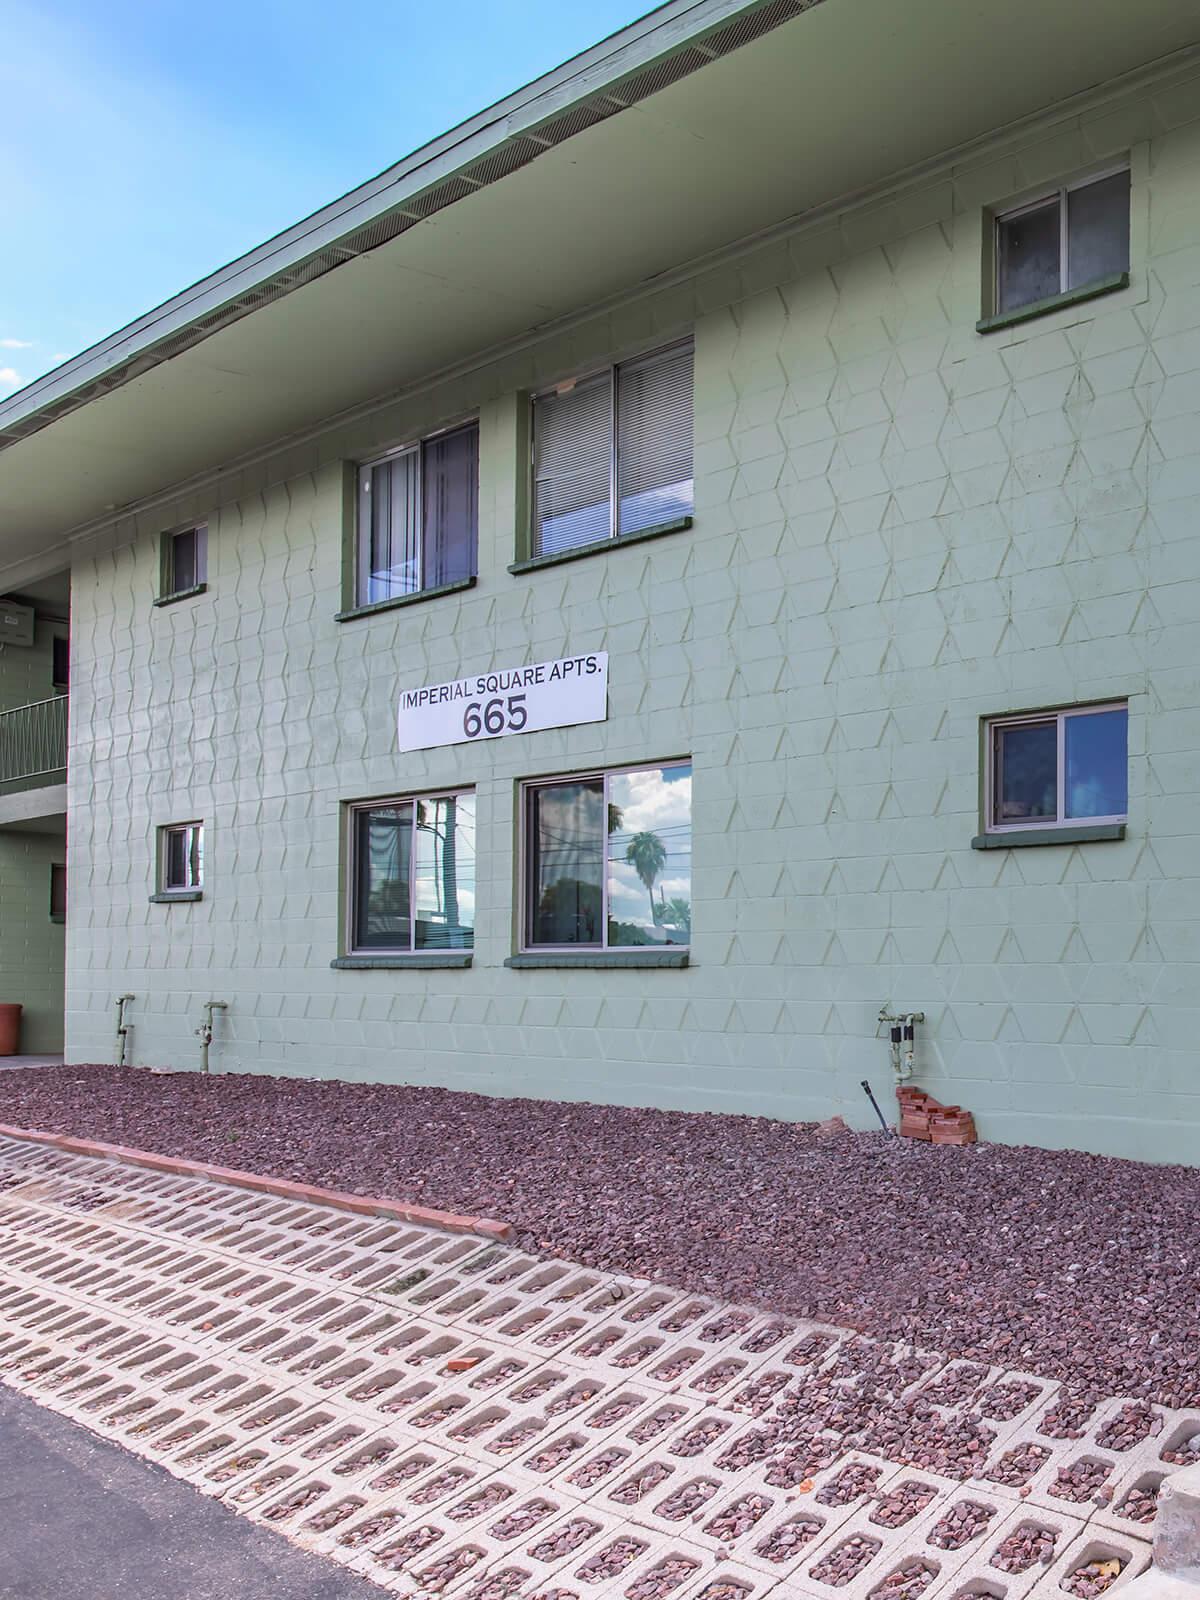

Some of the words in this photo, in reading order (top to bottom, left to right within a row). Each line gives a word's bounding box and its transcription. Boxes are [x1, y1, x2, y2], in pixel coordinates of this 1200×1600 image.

[403, 681, 473, 710] IMPERIAL
[477, 666, 545, 695] SQUARE
[549, 656, 602, 681] APTS.
[463, 694, 528, 738] 665
